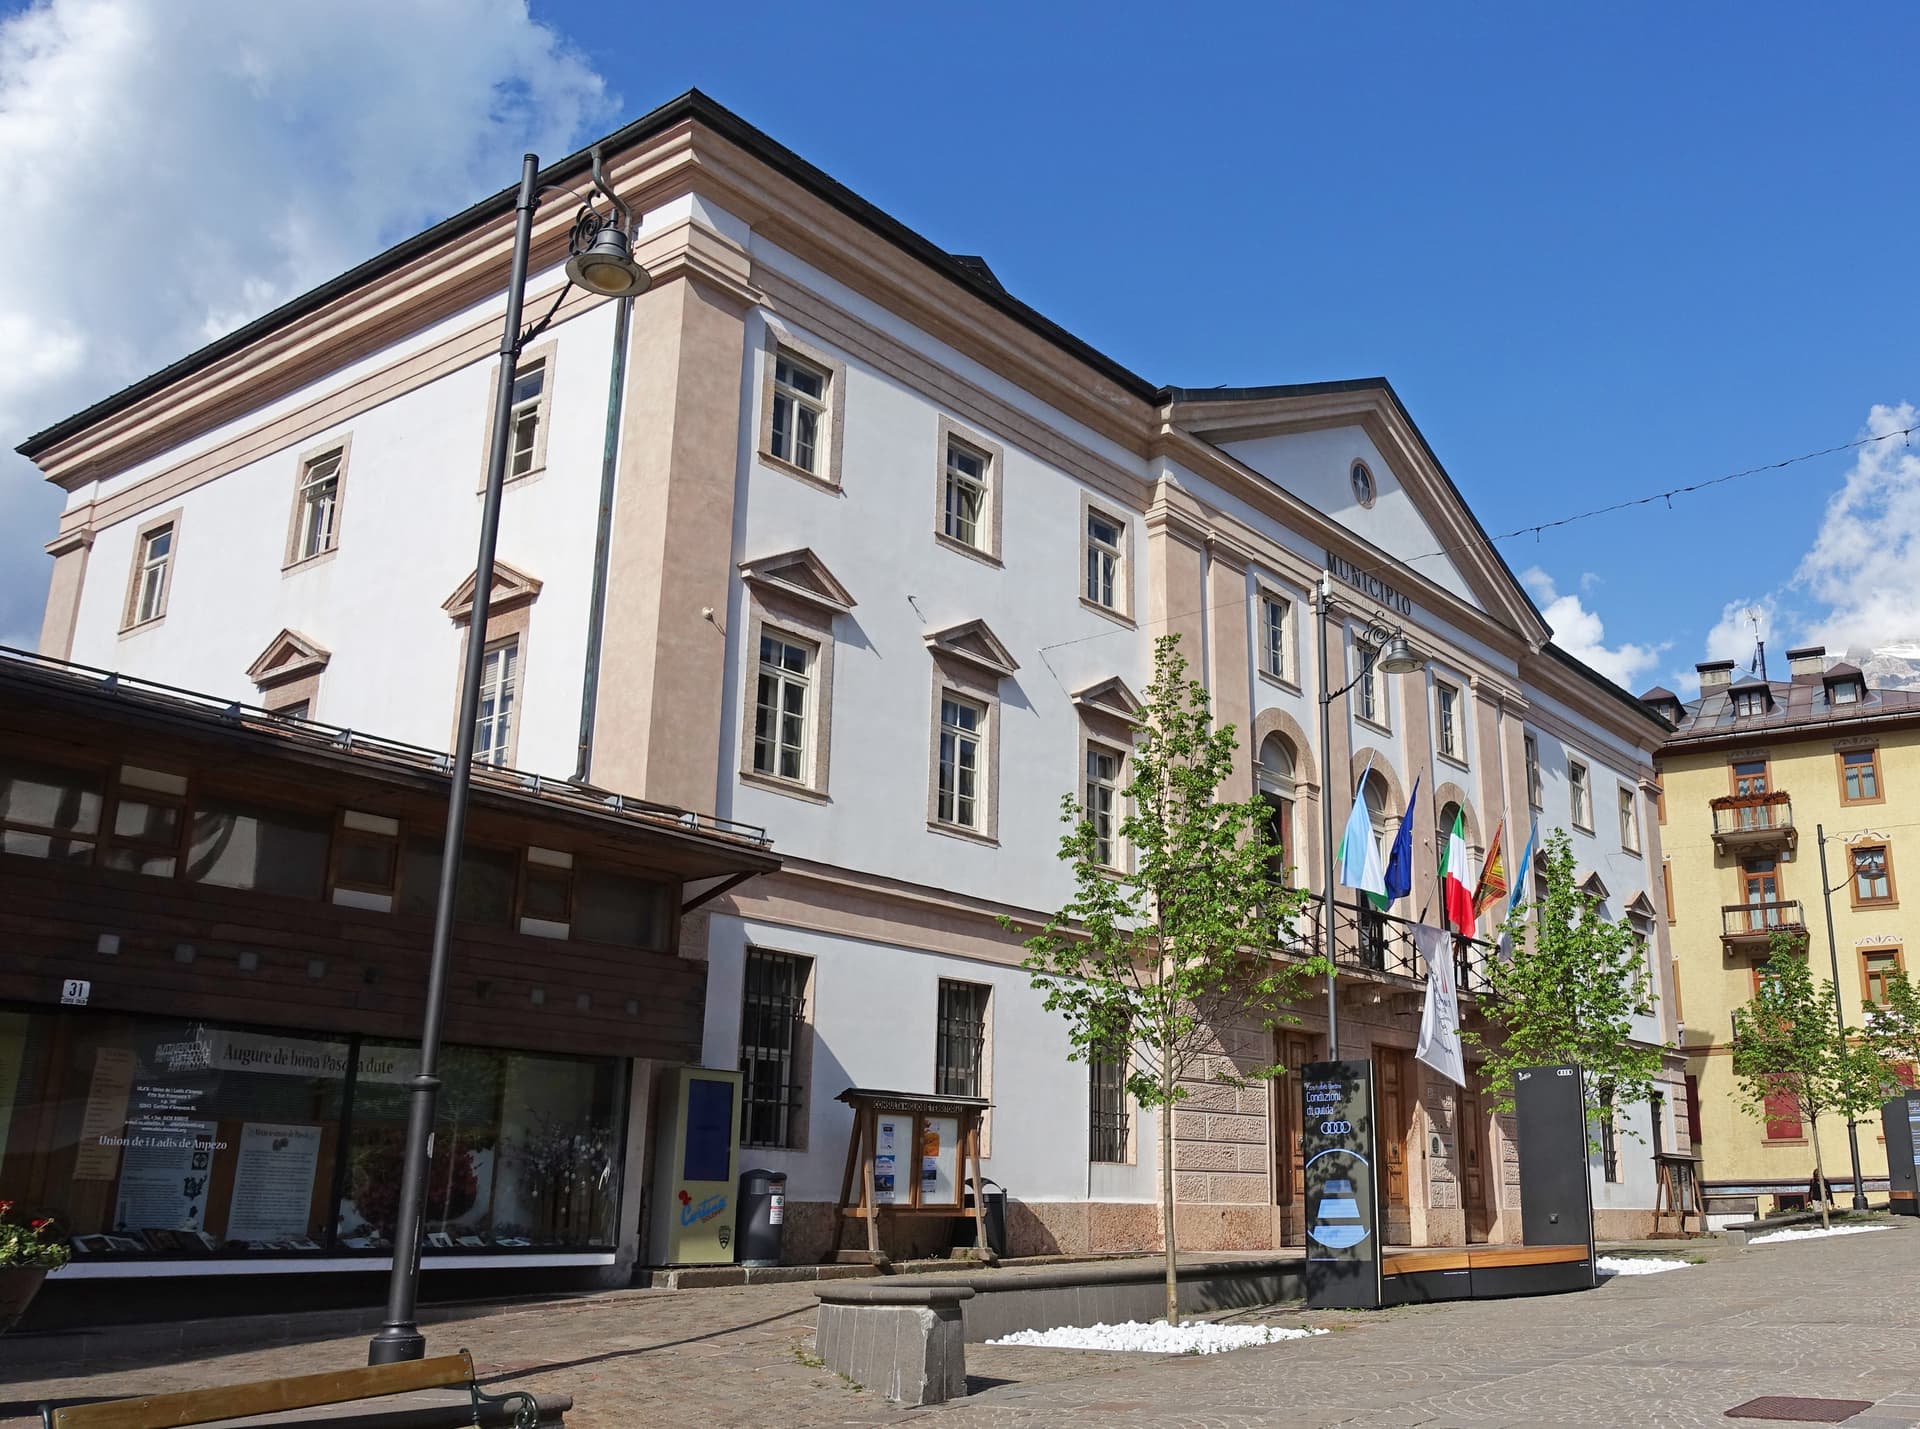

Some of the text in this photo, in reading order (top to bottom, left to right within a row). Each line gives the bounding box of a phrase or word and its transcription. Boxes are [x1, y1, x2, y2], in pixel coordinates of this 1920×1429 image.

[1327, 549, 1411, 616] MUNICIPIO
[69, 982, 83, 997] 31
[223, 1044, 271, 1065] Augure
[274, 1048, 289, 1065] de
[322, 1055, 353, 1073] Pasc
[366, 1057, 394, 1074] dute
[1306, 1091, 1341, 1102] Condizioni
[1306, 1104, 1334, 1118] di guida
[99, 1135, 130, 1146] Union
[131, 1135, 144, 1147] de
[151, 1136, 177, 1148] Ladis
[179, 1136, 191, 1148] de
[193, 1139, 228, 1151] Anpezo
